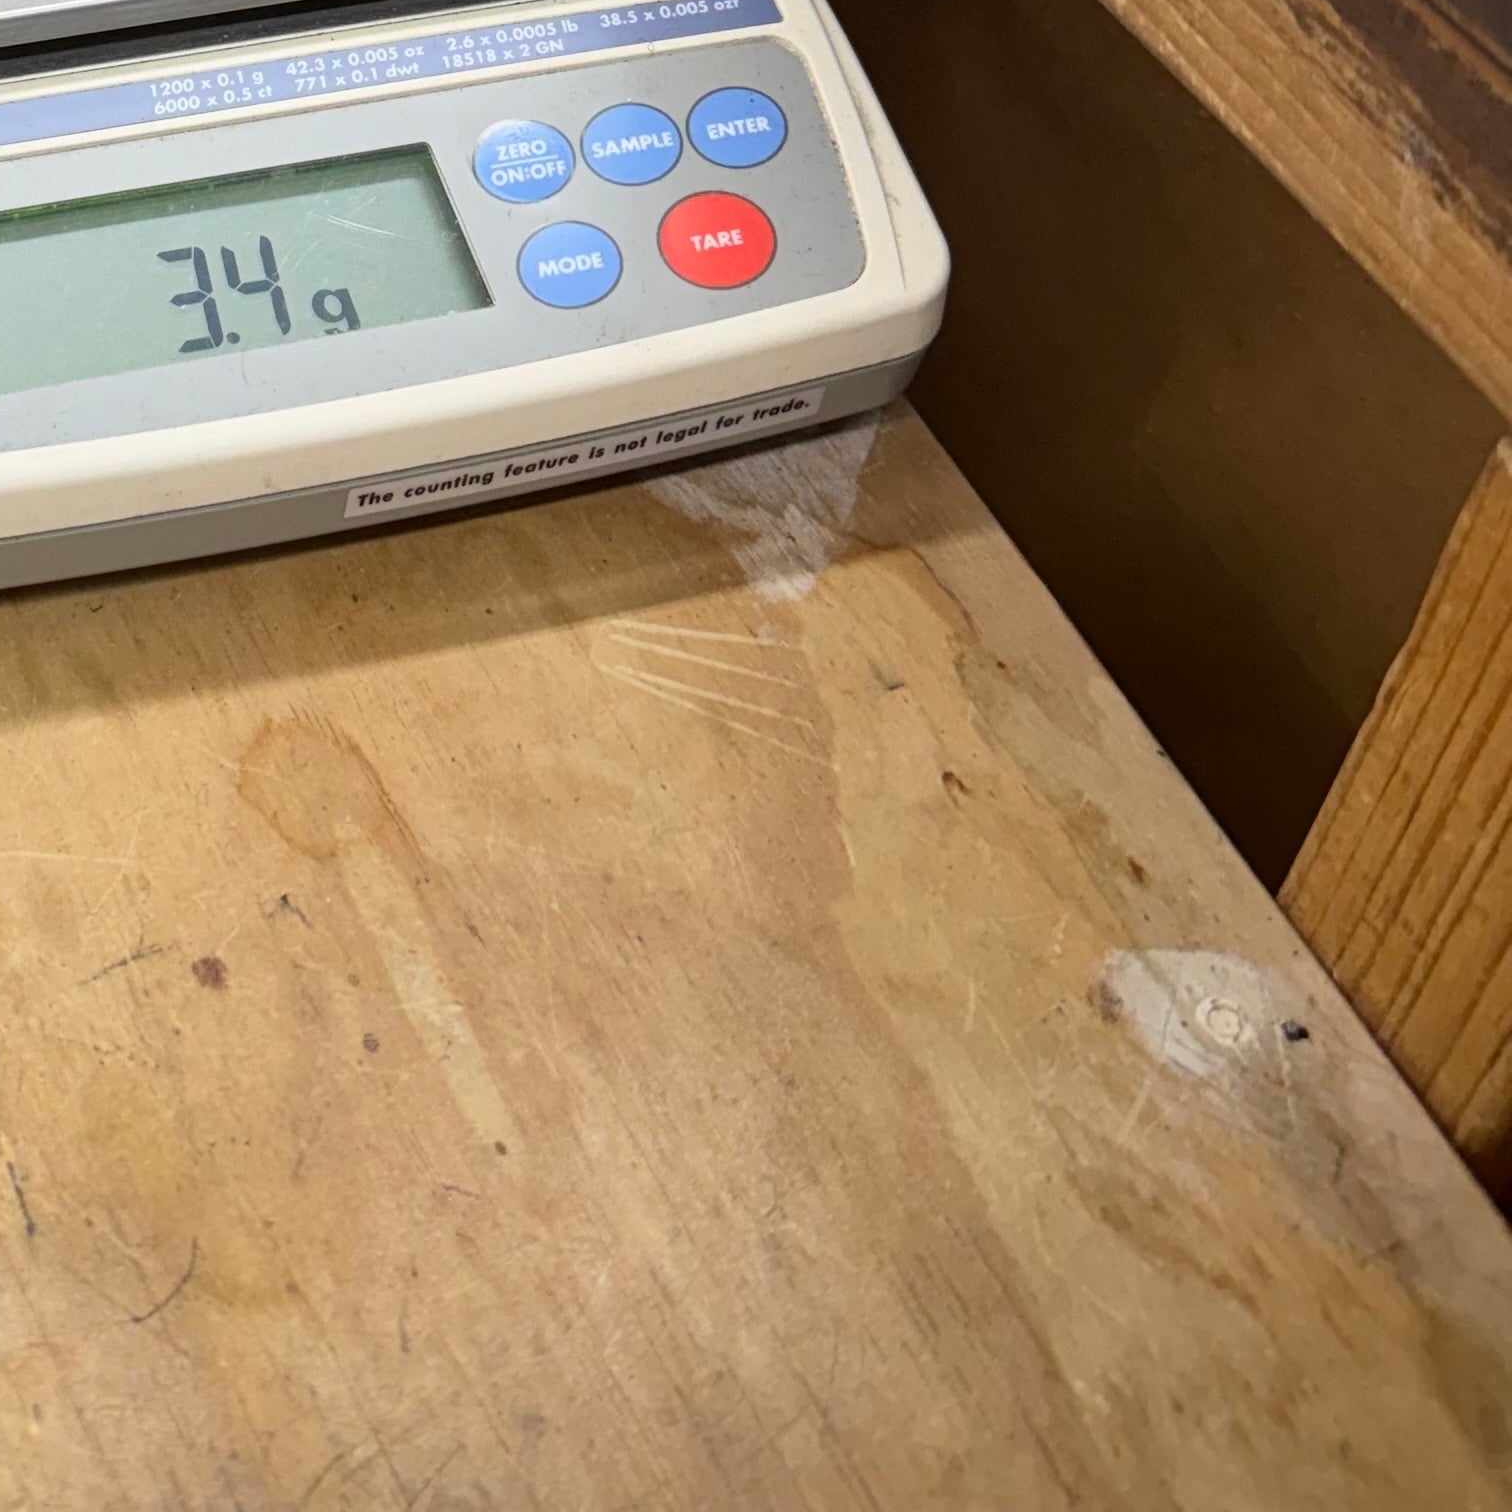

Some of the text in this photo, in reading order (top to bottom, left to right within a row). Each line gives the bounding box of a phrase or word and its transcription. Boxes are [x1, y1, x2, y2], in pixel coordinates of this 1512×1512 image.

[600, 11, 638, 28] 38.5
[644, 11, 654, 21] x
[659, 1, 709, 19] 0.005
[446, 19, 578, 51] 2.6 x 0.0005 lb
[285, 46, 424, 76] 42.3 x 0.005 oz
[441, 38, 565, 69] 18518 x 2 GN
[149, 71, 264, 98] 1200 x 0.1 g
[295, 62, 420, 93] 771 x 0.1 dwt
[154, 86, 273, 116] 6000 x 0.5 ct
[706, 116, 771, 140] ENTER
[496, 140, 548, 161] ZERO
[591, 131, 674, 159] SAMPLE
[690, 228, 744, 252] TARE
[538, 252, 604, 278] MODE
[156, 235, 361, 353] 3.4 g
[358, 397, 811, 507] The counting feature is not legal for trade.
